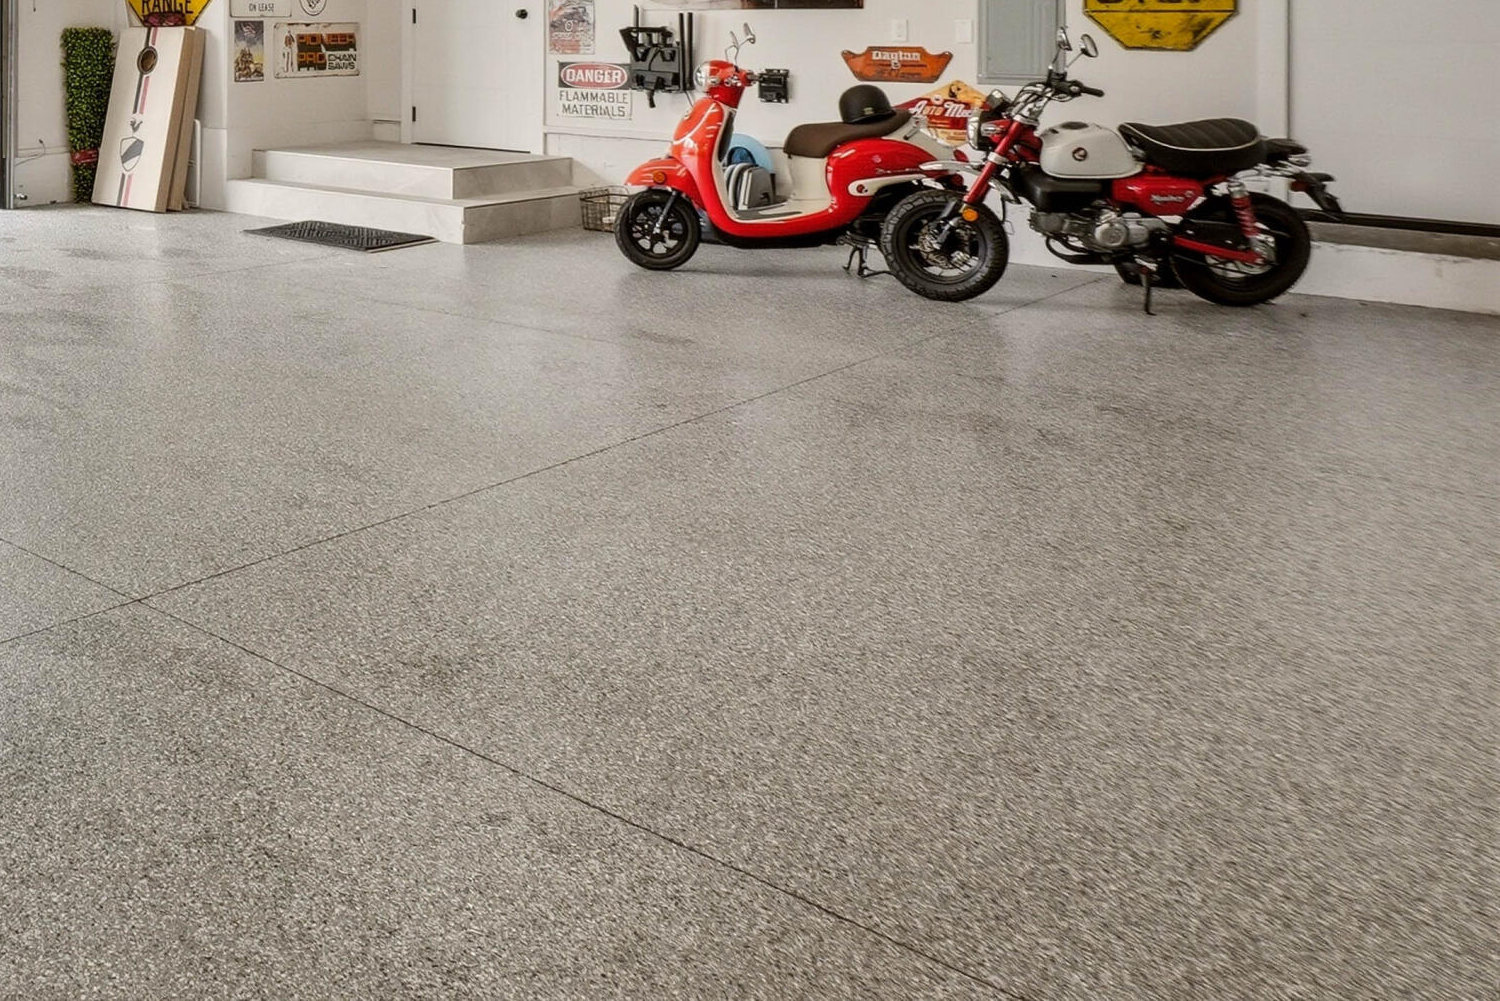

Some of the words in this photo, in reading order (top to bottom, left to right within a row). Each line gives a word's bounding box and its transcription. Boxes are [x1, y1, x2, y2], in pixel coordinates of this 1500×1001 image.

[566, 69, 622, 84] DANGER
[559, 90, 629, 104] FLAMMABLE
[562, 103, 626, 117] MATERIALS
